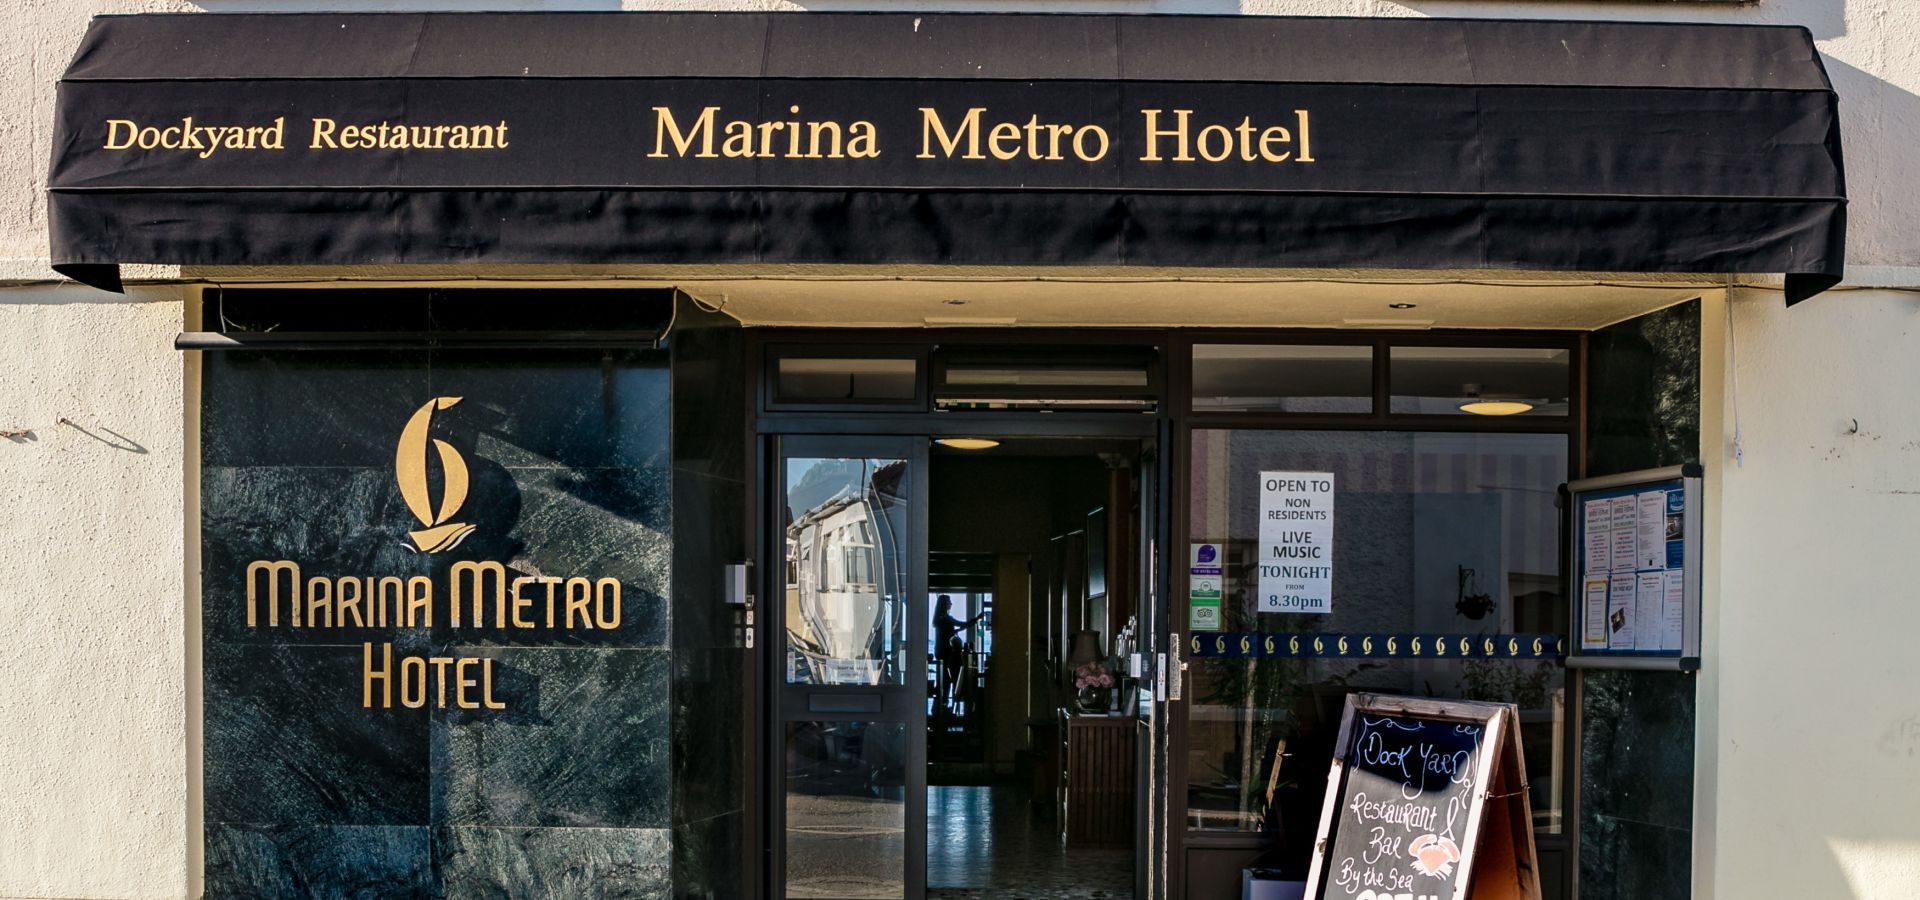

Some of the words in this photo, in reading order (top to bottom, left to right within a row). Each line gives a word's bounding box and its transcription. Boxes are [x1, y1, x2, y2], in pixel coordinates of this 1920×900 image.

[103, 117, 285, 159] Dockyard
[309, 118, 508, 149] Restaurant
[647, 105, 880, 160] Marina
[916, 107, 1110, 162] Metro
[1139, 109, 1315, 163] Hotel
[1266, 479, 1306, 492] OPEN
[1311, 480, 1331, 493] TO
[1285, 498, 1311, 508] NON
[1268, 510, 1327, 520] RESIDENTS
[1282, 531, 1312, 544] LIVE
[1273, 546, 1321, 559] MUSIC
[1260, 565, 1331, 579] TONIGHT
[1269, 595, 1323, 610] 8.30pm
[1335, 857, 1360, 894] By
[1363, 867, 1385, 887] the
[1385, 868, 1414, 892] Sea
